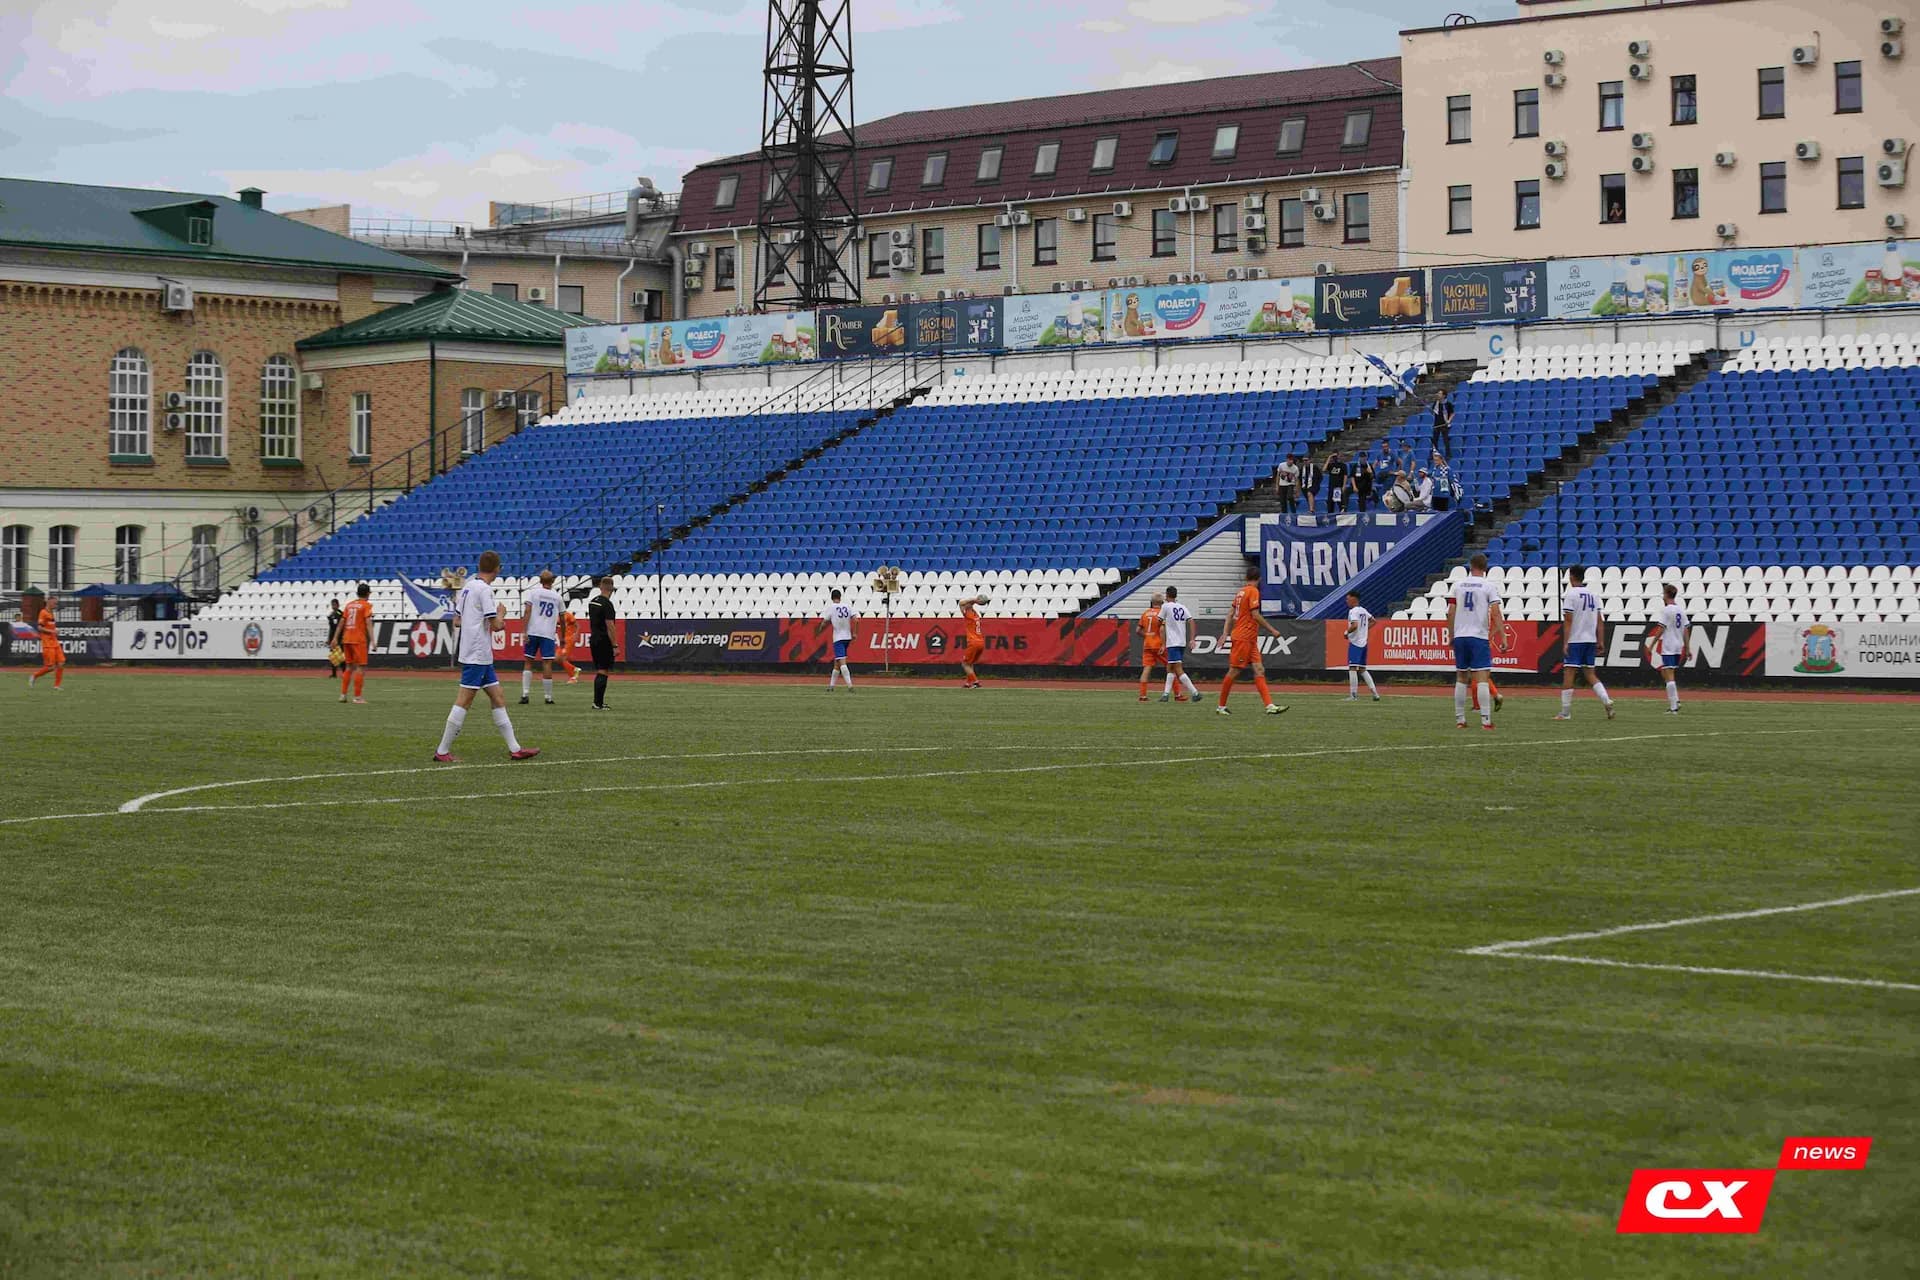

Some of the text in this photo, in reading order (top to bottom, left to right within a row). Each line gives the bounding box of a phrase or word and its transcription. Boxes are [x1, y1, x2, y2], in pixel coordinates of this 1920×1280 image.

[1731, 264, 1780, 276] МОДЕСТ
[1443, 283, 1488, 299] ЧАСТИЦА
[1158, 297, 1198, 310] МОДЕСТ
[1444, 298, 1476, 313] АЛТАЯ
[1266, 541, 1396, 588] BARNA
[1464, 592, 1475, 612] 4
[1580, 593, 1596, 612] 74
[539, 601, 555, 618] 78
[836, 606, 849, 619] 33
[1172, 607, 1186, 621] 82
[1675, 613, 1682, 629] 8
[731, 635, 764, 646] PRO
[870, 633, 920, 650] LEON
[955, 636, 1009, 650] ЛГА
[1384, 627, 1419, 648] ОДНА
[1422, 627, 1440, 645] НА
[1384, 649, 1418, 661] КОМАНДА,
[1419, 649, 1448, 661] РОДИНА,
[1492, 656, 1518, 665] ФНЛ
[1859, 651, 1911, 665] ГОРОДА
